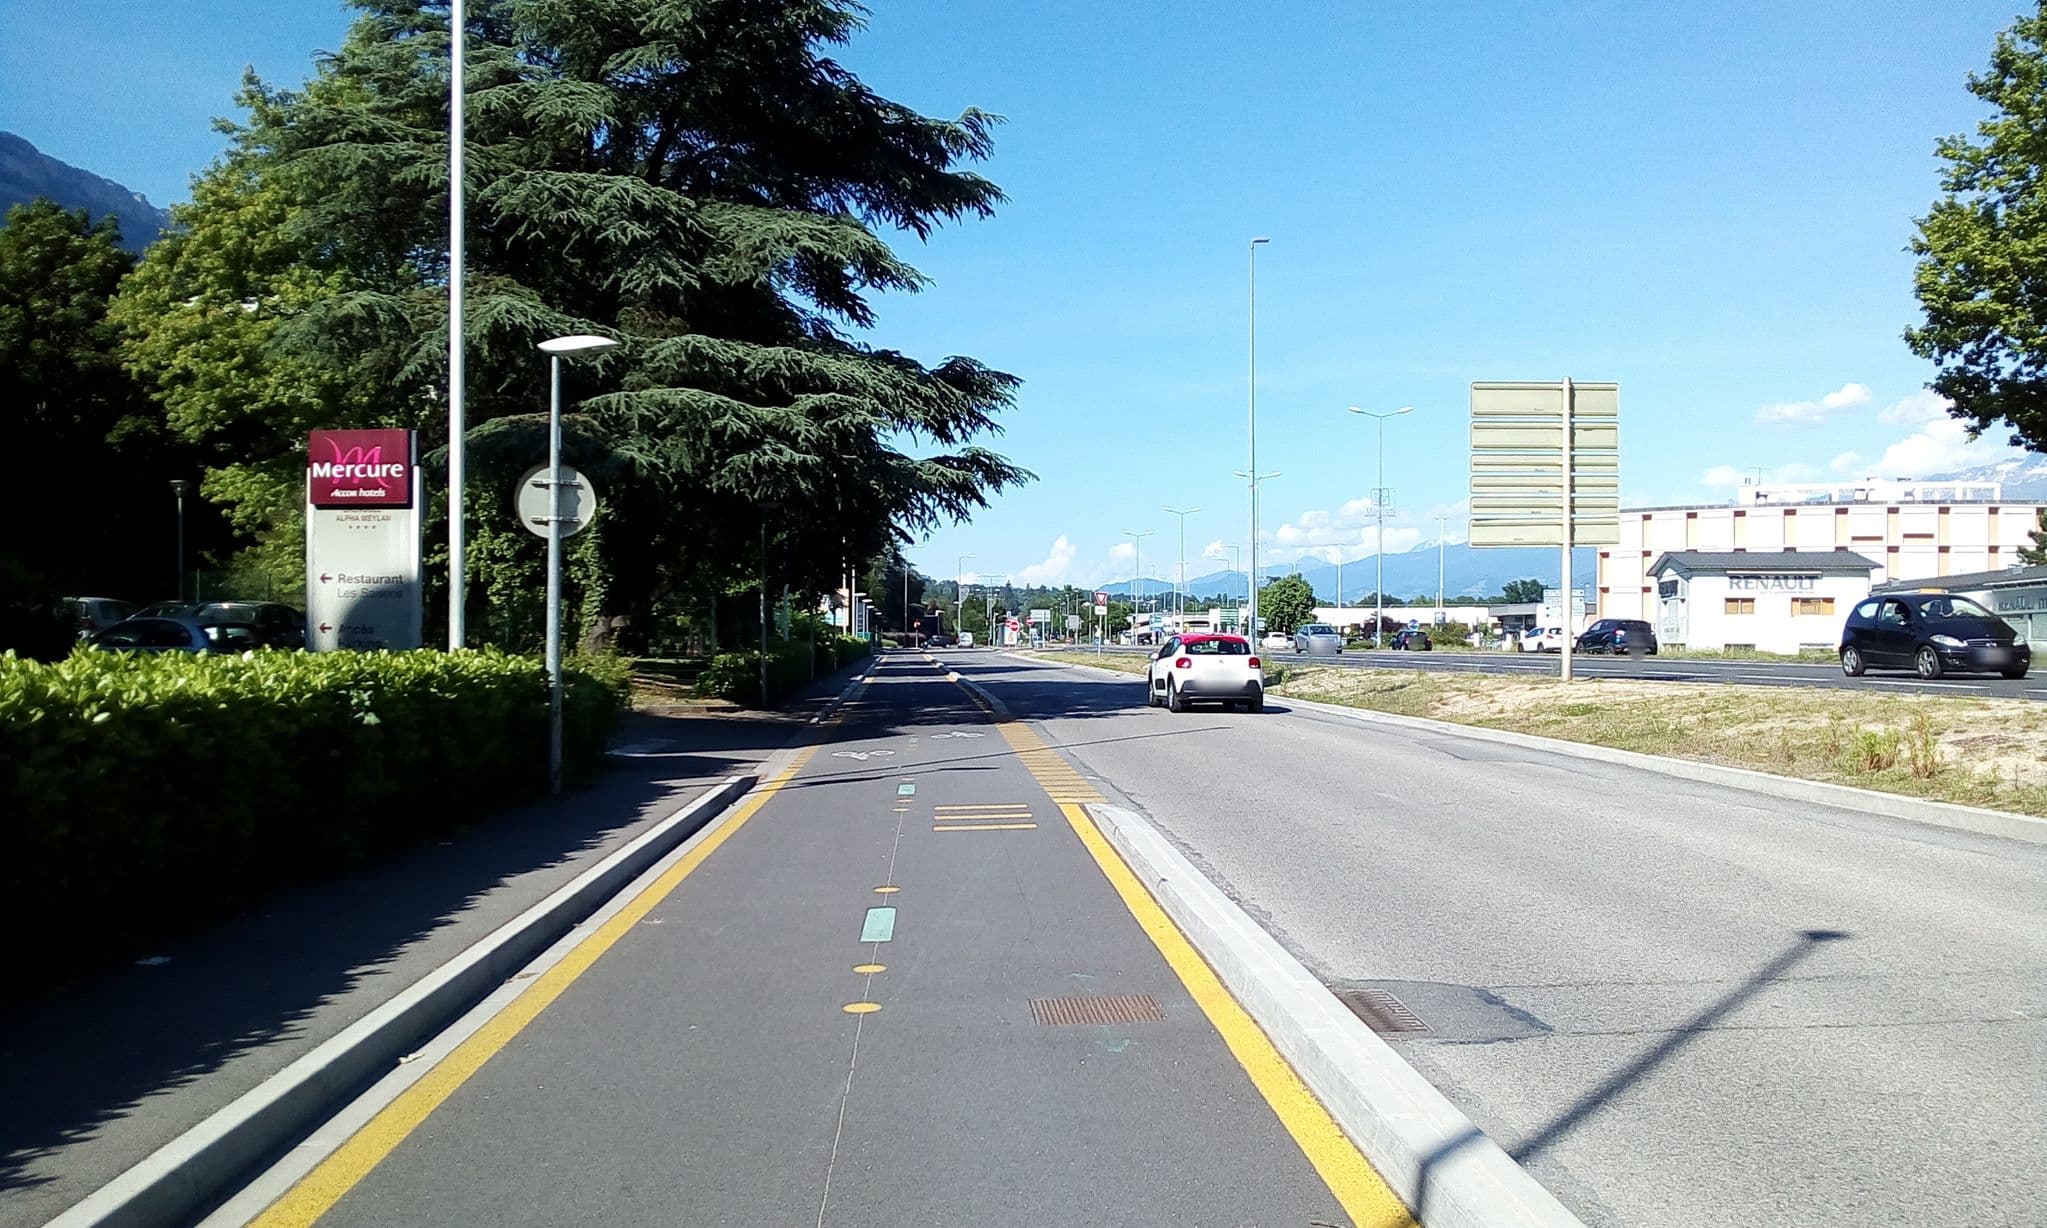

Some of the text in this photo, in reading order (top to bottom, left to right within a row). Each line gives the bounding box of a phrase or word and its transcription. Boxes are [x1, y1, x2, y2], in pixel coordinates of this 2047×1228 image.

[312, 461, 404, 478] Mercure
[358, 487, 386, 498] hotels
[336, 514, 391, 522] ALPHA MEYLAN
[337, 573, 403, 584] Restaurant
[1728, 575, 1818, 590] RENAULT
[337, 588, 356, 598] Les
